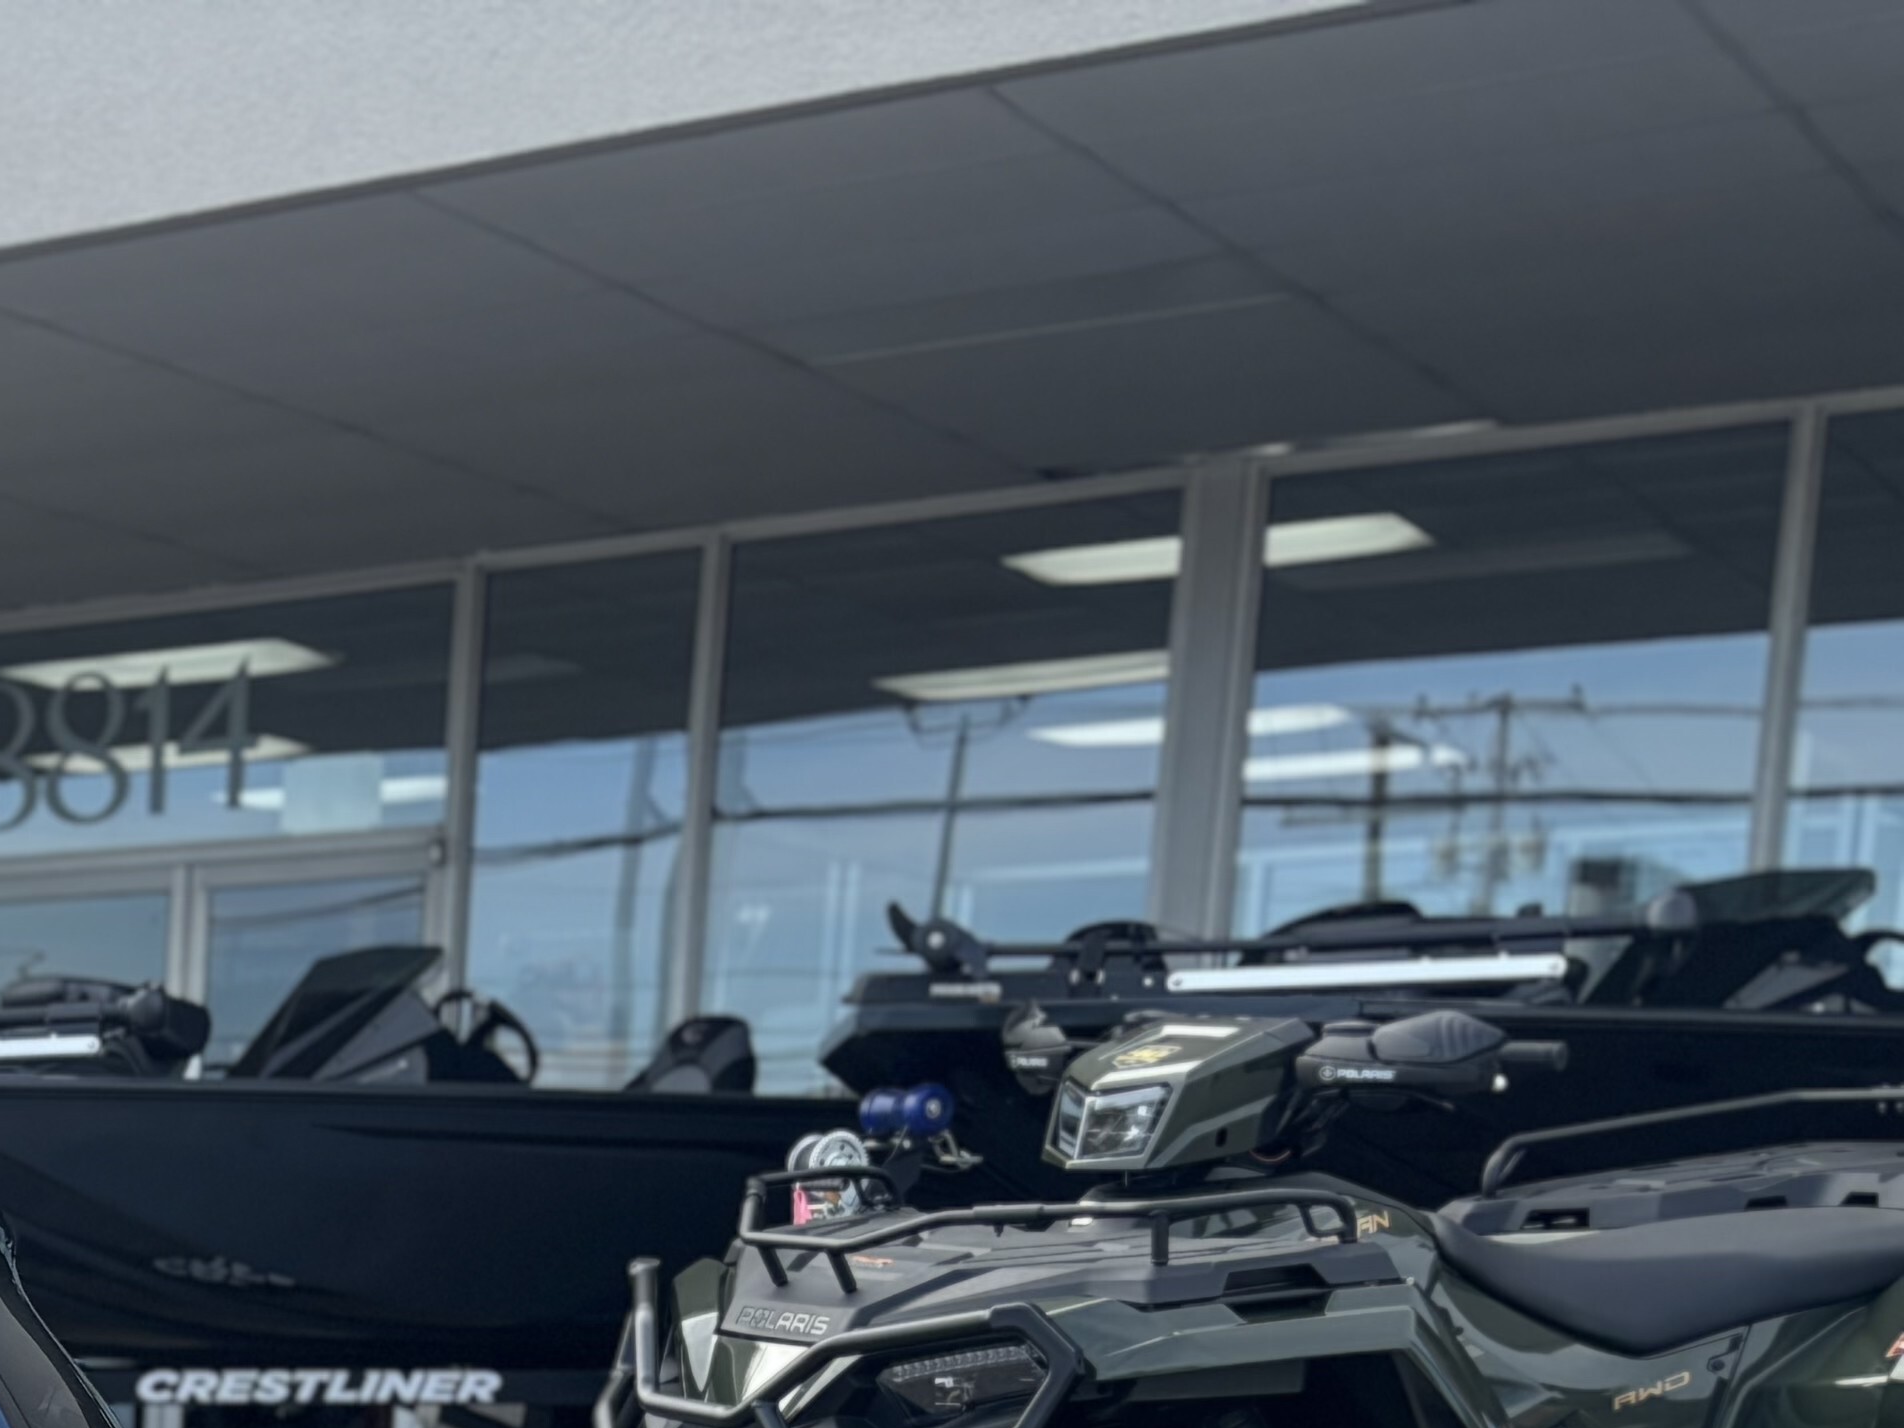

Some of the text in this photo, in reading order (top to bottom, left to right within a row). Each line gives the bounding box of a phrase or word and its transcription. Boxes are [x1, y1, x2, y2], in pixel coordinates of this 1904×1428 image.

[1337, 1068, 1395, 1079] POLARIS
[736, 1305, 830, 1336] POLARIS
[136, 1368, 502, 1404] CRESTLINER
[1615, 1371, 1690, 1410] AWD
